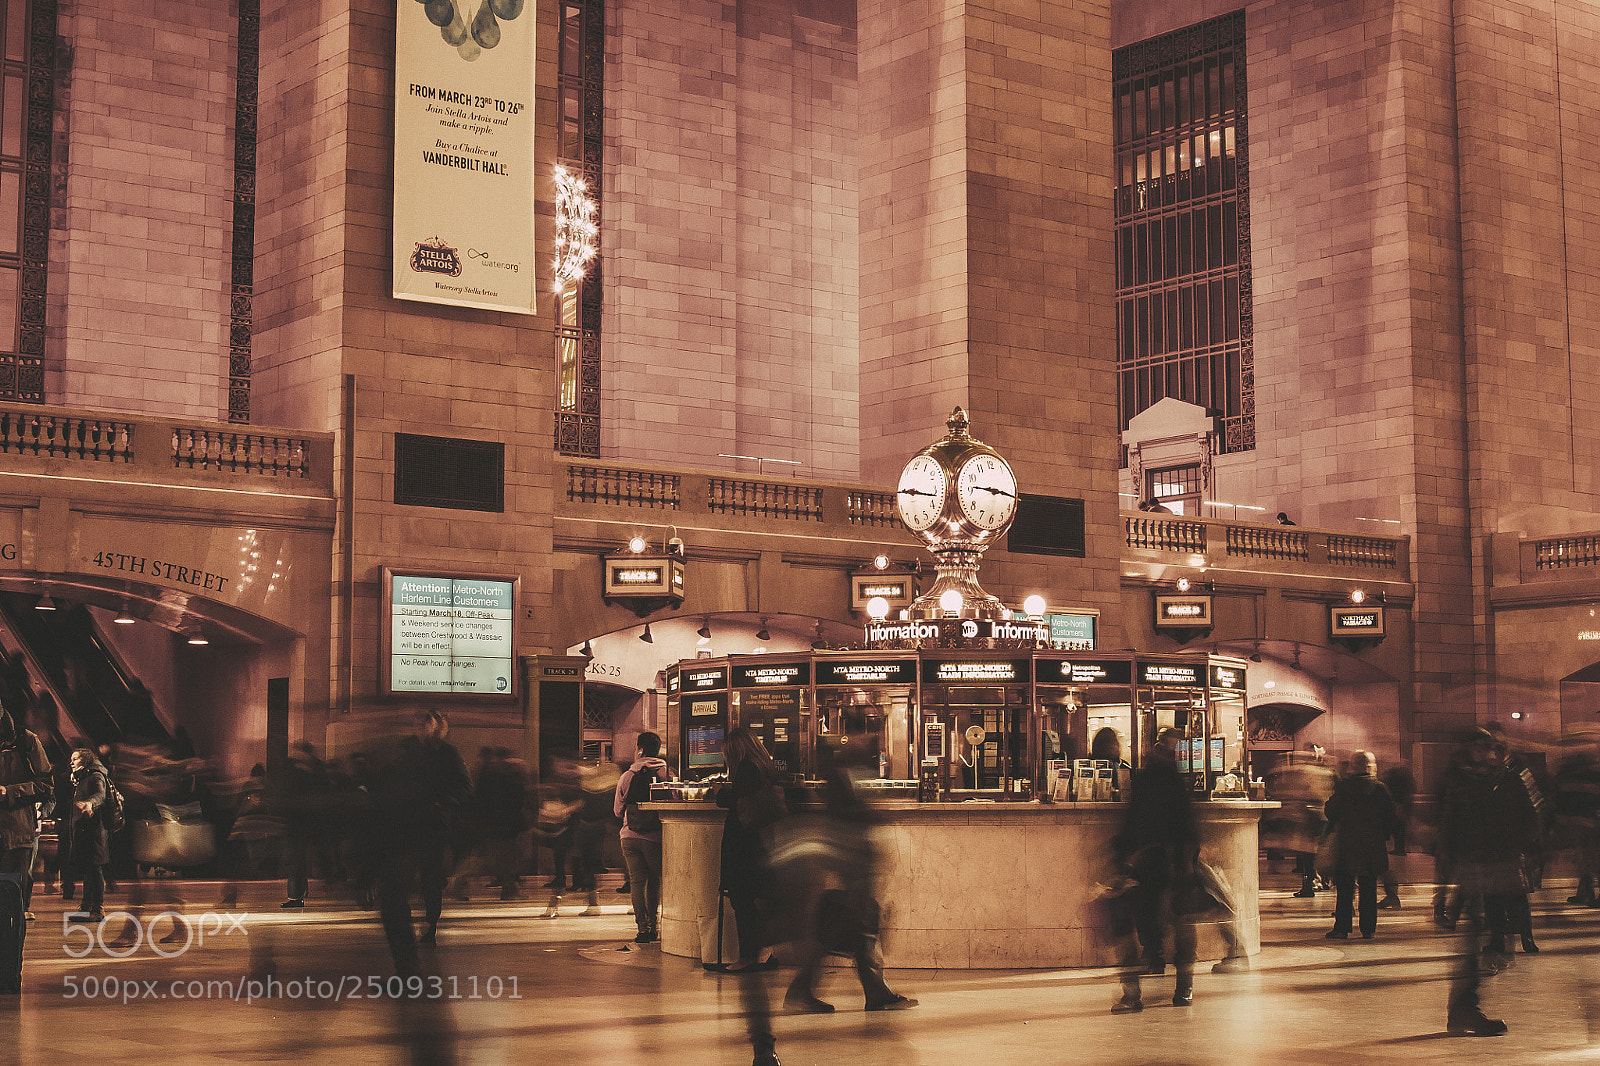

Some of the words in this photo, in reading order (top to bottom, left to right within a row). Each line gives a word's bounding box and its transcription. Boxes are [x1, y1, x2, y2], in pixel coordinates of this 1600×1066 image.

[410, 84, 436, 100] FROM
[439, 88, 472, 106] MARCH
[474, 96, 492, 108] 23RD
[494, 100, 505, 112] TO
[508, 102, 524, 114] 26TH
[426, 104, 443, 114] Join
[444, 106, 466, 118] Stella
[468, 112, 491, 123] Artois
[493, 118, 508, 126] and
[440, 119, 460, 128] make
[469, 124, 494, 135] ripple.
[436, 138, 451, 152] Buy
[460, 143, 488, 155] Chalice
[423, 150, 480, 172] VANDERBILT
[420, 250, 452, 261] STELLA
[420, 258, 453, 270] ARTOIS
[977, 464, 983, 473] 11
[987, 461, 994, 469] 12
[969, 474, 976, 483] 10
[968, 486, 973, 496] 9
[930, 500, 935, 509] 4
[971, 501, 976, 510] 8
[914, 515, 919, 524] 6
[923, 511, 928, 520] 5
[980, 510, 985, 520] 7
[989, 514, 994, 524] 6
[93, 552, 146, 574] 45TH
[151, 560, 229, 593] STREET
[620, 571, 646, 580] TRACK
[402, 582, 450, 593] Attention:
[453, 584, 503, 596] Metro-North
[402, 594, 432, 603] Harlem
[434, 595, 451, 604] Line
[454, 596, 499, 606] Customers
[402, 608, 428, 617] Starting
[466, 611, 494, 619] Off-Peak
[466, 622, 493, 630] changes
[1051, 619, 1087, 628] Metro-North
[431, 631, 467, 639] Crestwood
[870, 622, 938, 641] Information
[1052, 628, 1084, 637] Customers
[447, 660, 476, 668] changes.
[609, 666, 621, 677] 25
[758, 668, 798, 676] METRO-NORTH
[1159, 667, 1194, 675] METRO-NORTH
[694, 704, 716, 713] ARRIVALS
